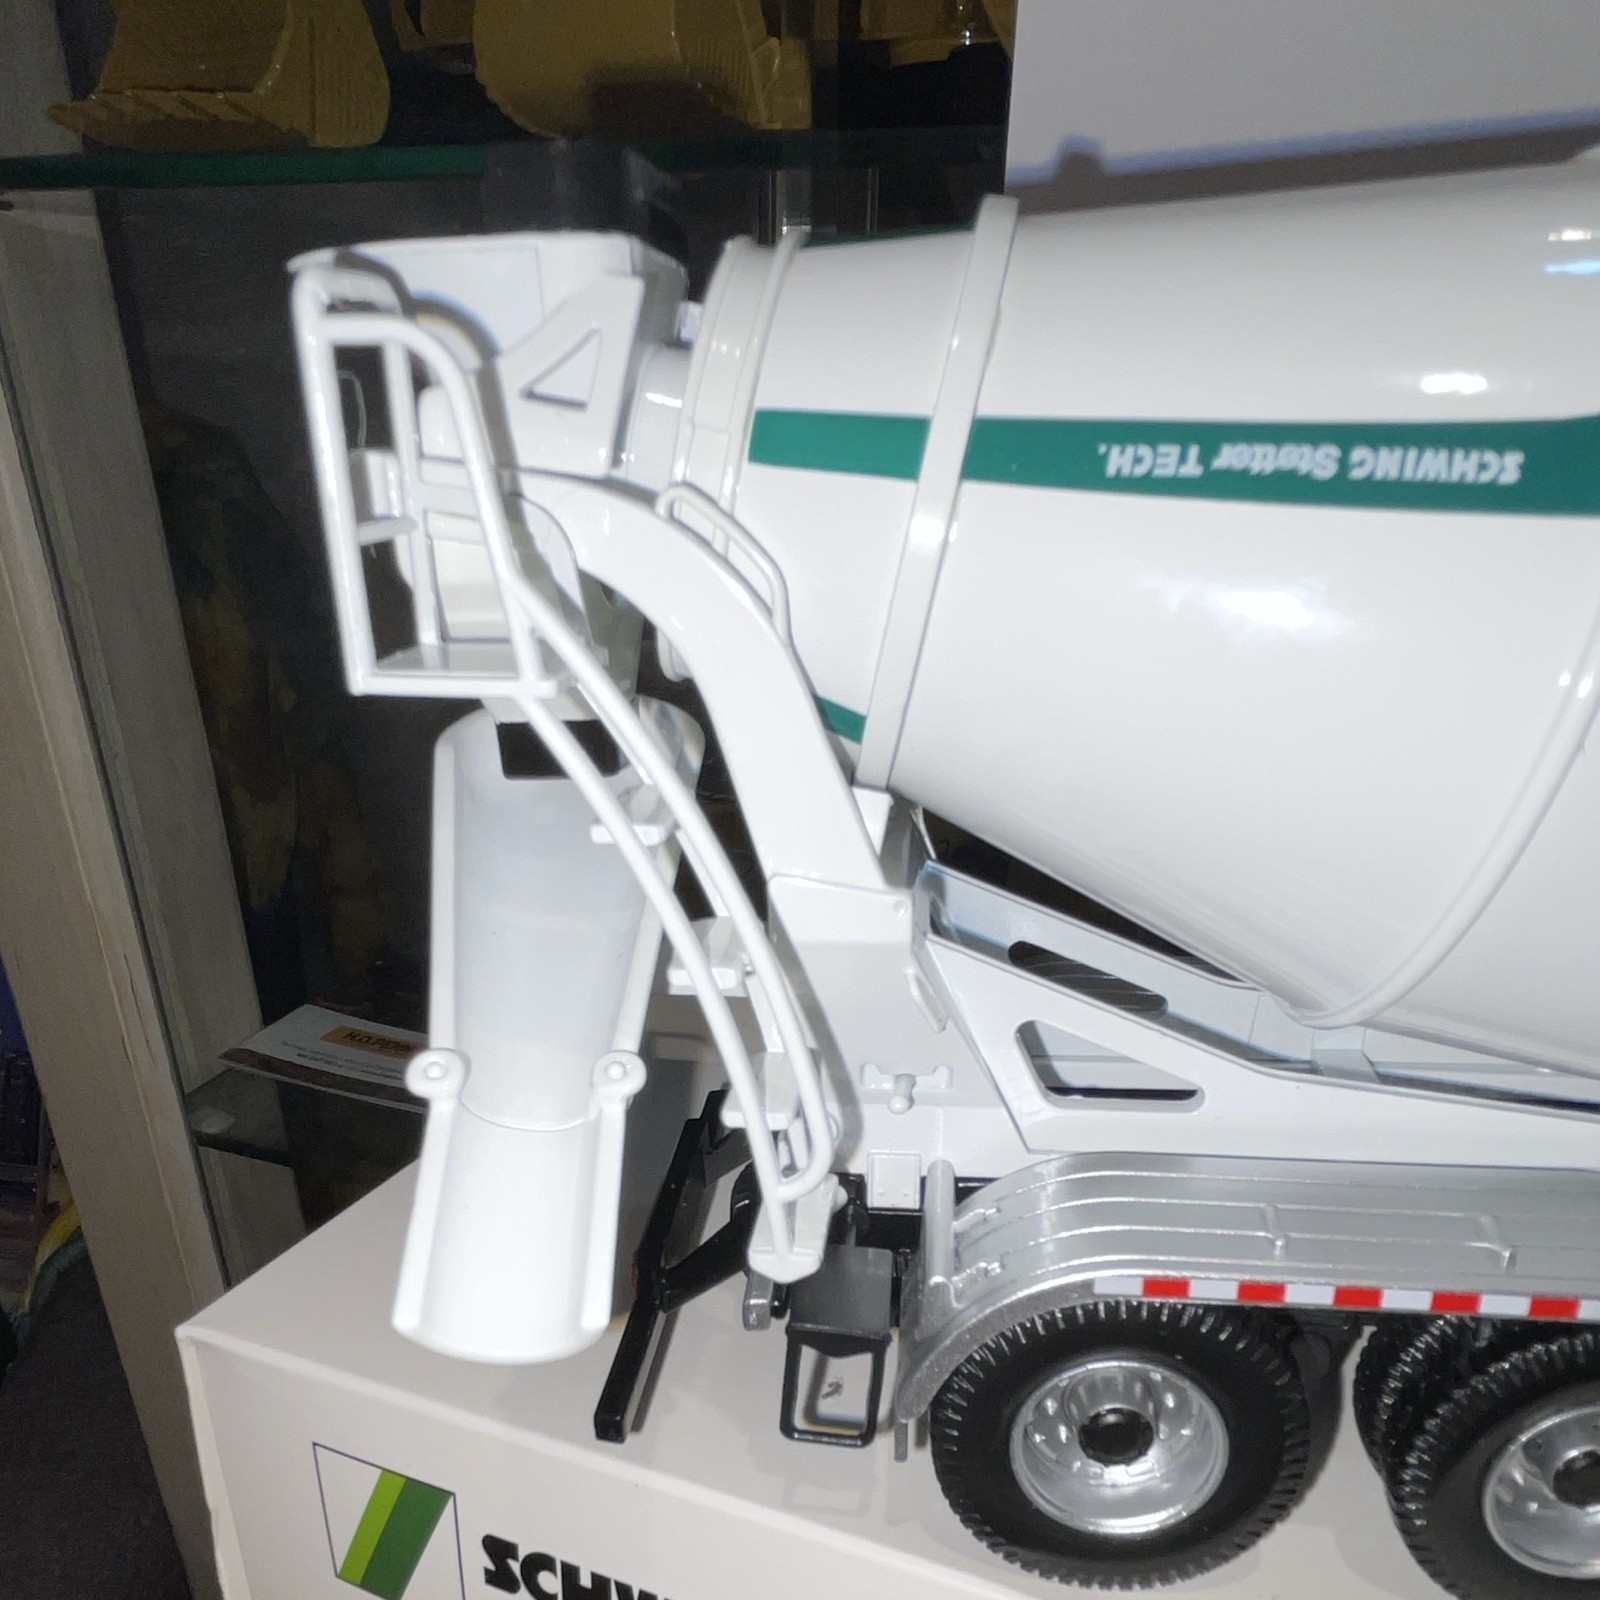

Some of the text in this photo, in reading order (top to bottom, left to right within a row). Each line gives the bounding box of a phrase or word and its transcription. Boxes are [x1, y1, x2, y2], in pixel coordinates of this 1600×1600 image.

[1098, 443, 1204, 478] TECH.
[1349, 446, 1525, 485] SCHWING
[481, 1534, 674, 1600] SCH
